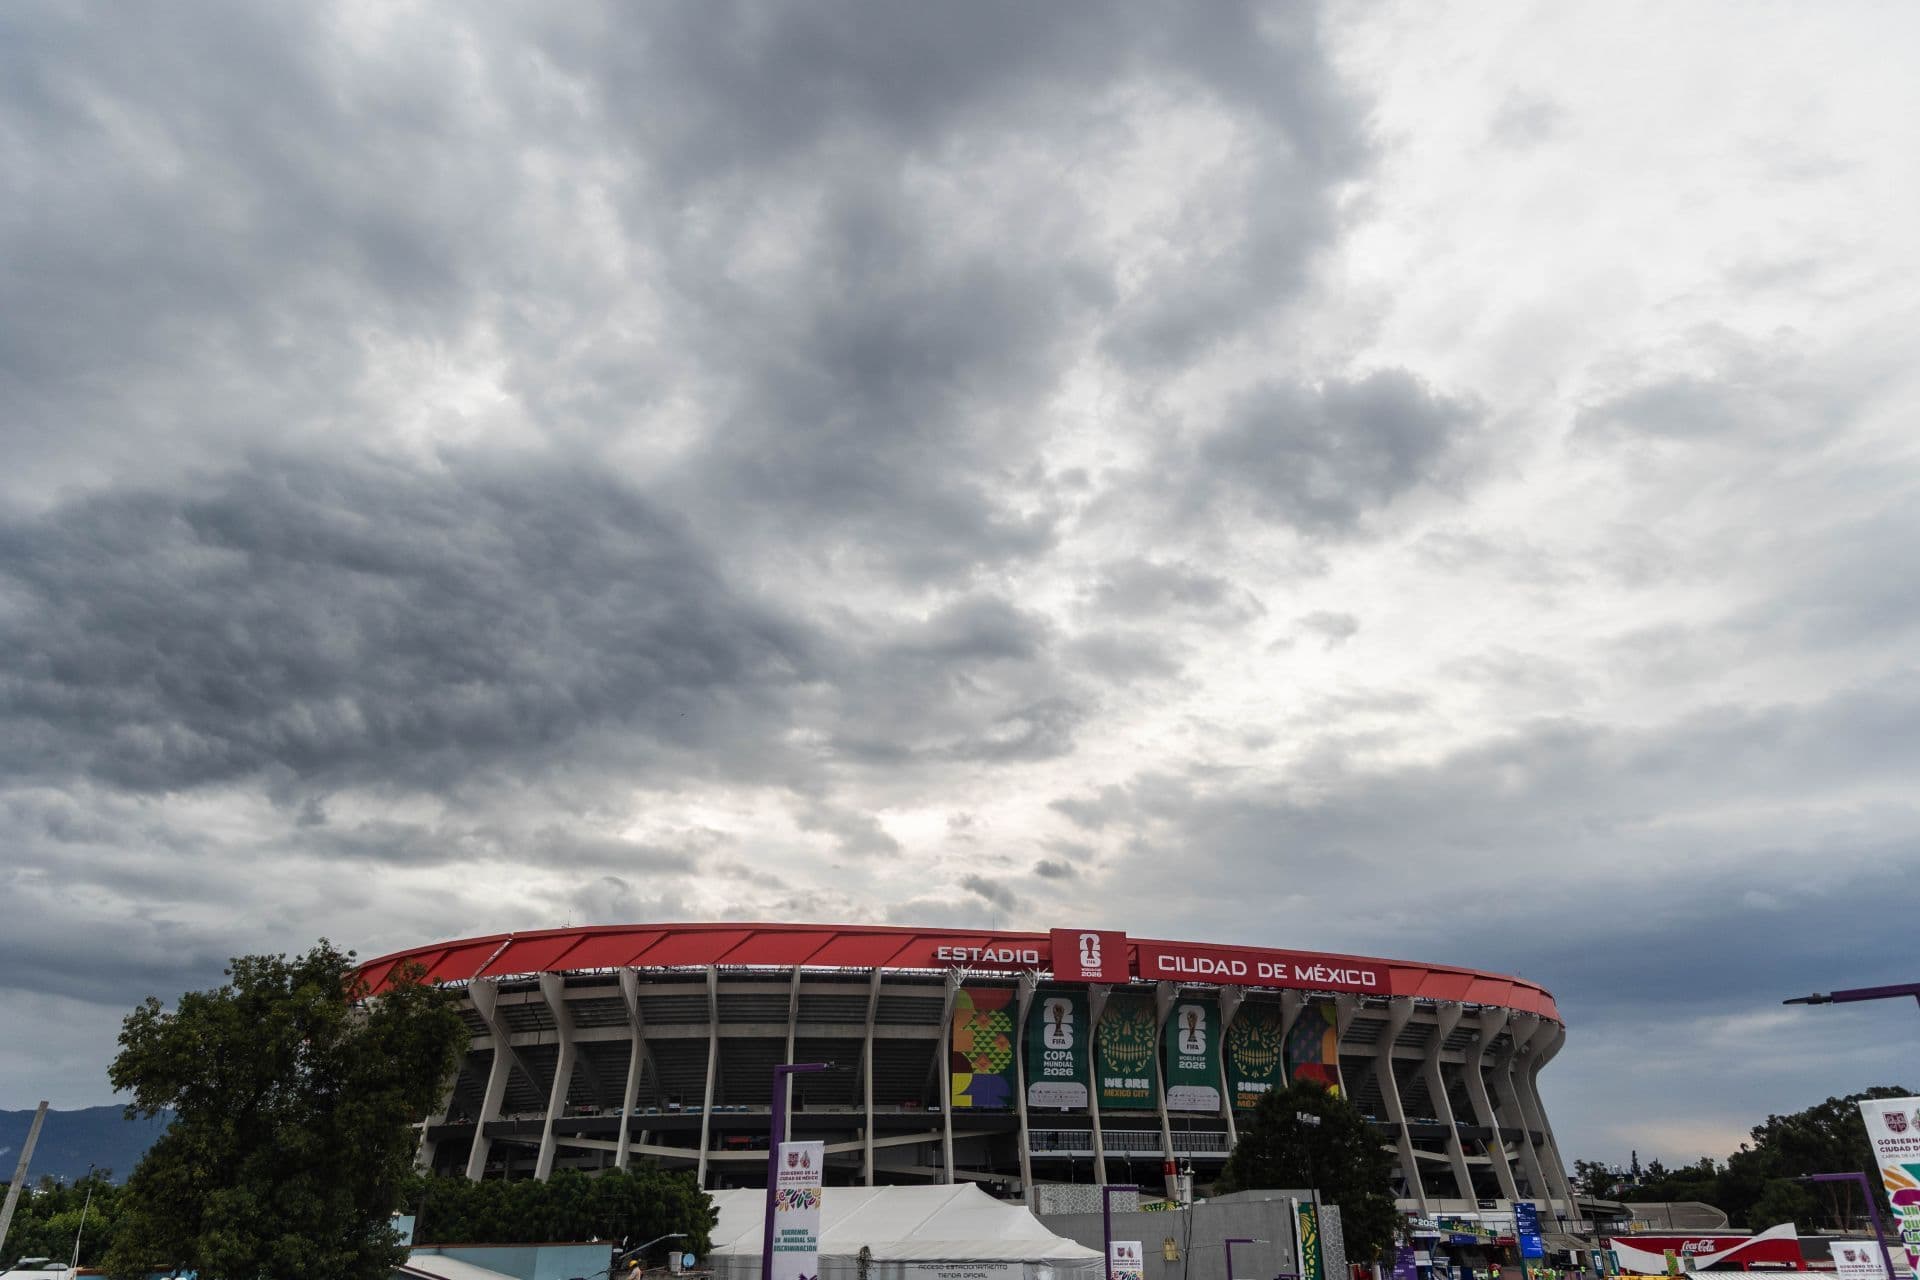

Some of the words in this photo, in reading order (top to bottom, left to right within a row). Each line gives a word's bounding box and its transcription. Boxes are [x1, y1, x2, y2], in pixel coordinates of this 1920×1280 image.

[937, 946, 1039, 964] ESTADIO
[1158, 954, 1247, 976] CIUDAD
[1257, 962, 1288, 979] DE
[1295, 963, 1377, 986] MÉXICO
[1043, 1050, 1074, 1061] COPA
[1178, 1061, 1207, 1070] 2026
[1043, 1068, 1074, 1076] 2026
[1104, 1077, 1124, 1088] WE
[1132, 1090, 1149, 1098] CITY
[1236, 1099, 1256, 1108] MÉX
[1877, 1137, 1920, 1146] GOBIERN
[1880, 1145, 1911, 1153] CIUDAD
[1418, 1218, 1439, 1228] 2026
[1681, 1239, 1715, 1256] Coca-Cola
